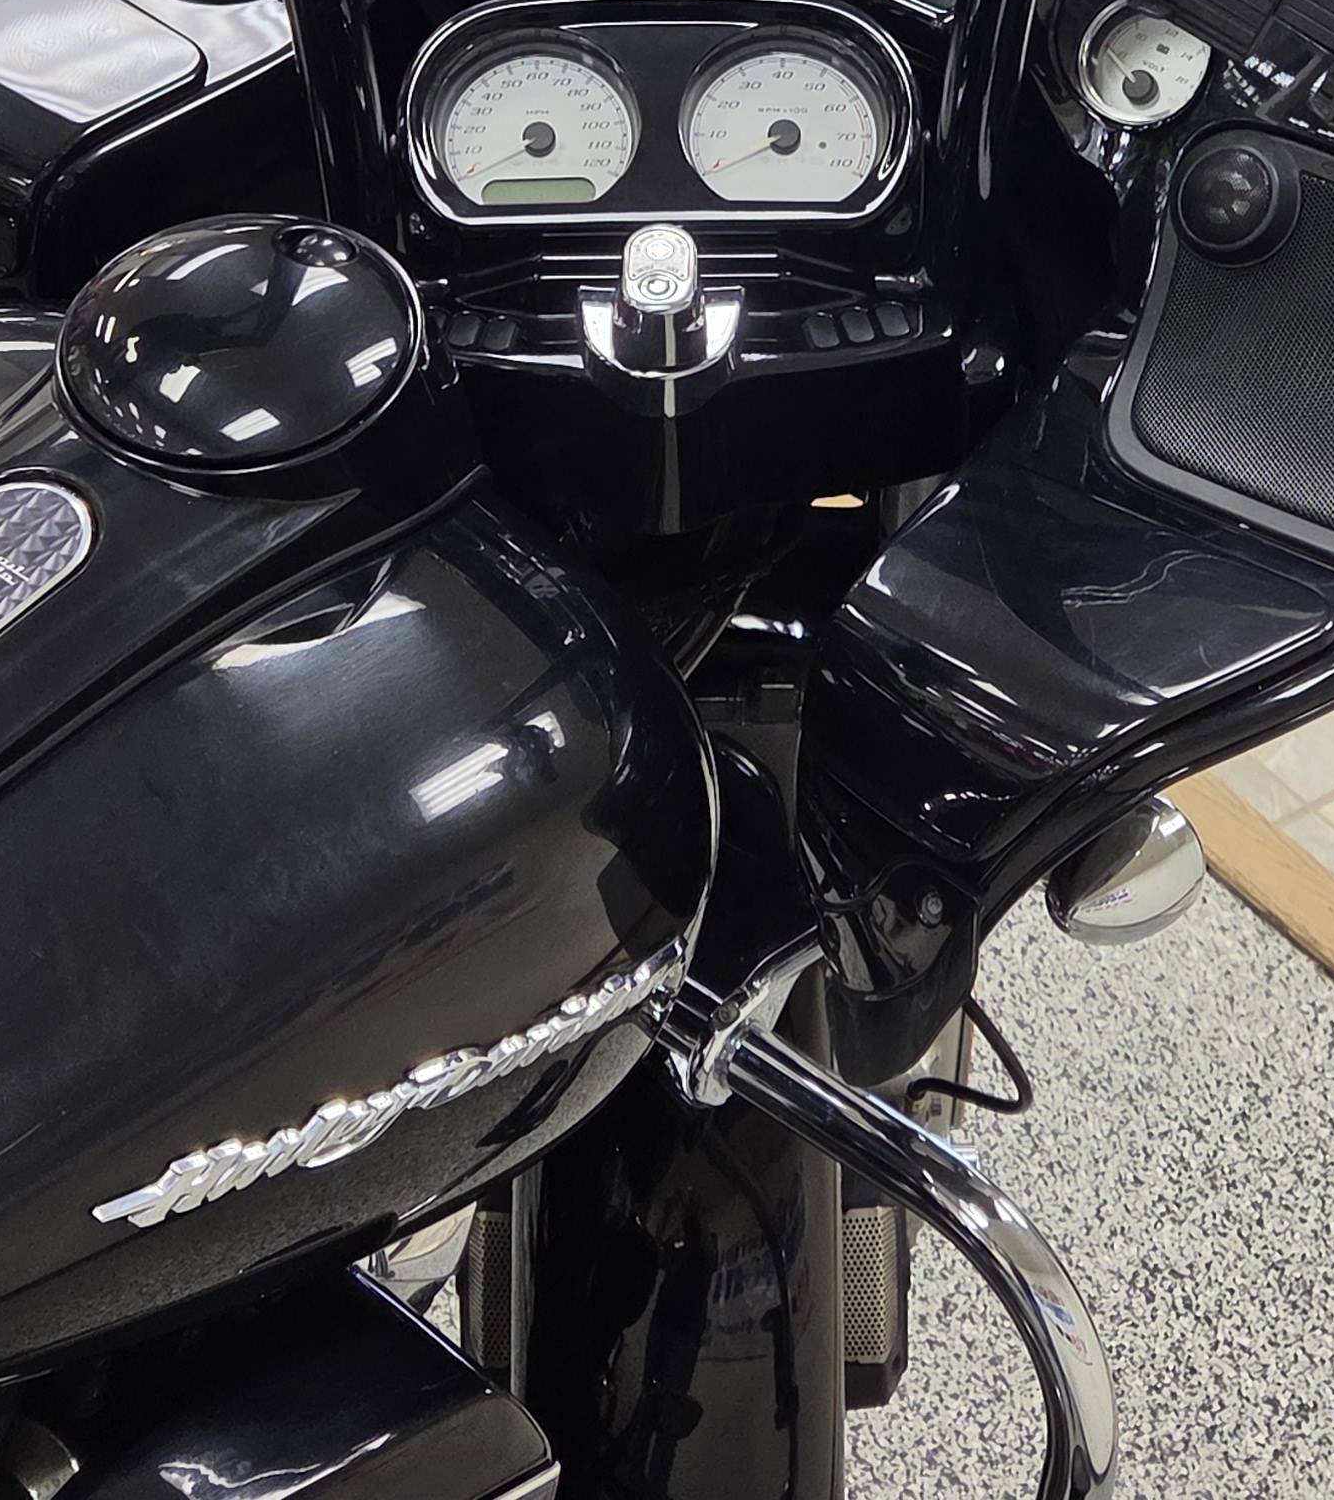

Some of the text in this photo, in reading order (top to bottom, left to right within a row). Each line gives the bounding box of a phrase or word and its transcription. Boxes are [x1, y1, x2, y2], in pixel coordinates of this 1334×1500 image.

[526, 72, 549, 81] 60
[772, 71, 794, 79] 40
[500, 79, 524, 89] 50
[552, 77, 572, 87] 70
[738, 82, 762, 90] 30
[803, 83, 826, 91] 50
[481, 92, 503, 101] 40
[567, 88, 590, 97] 80
[579, 102, 602, 112] 90
[717, 101, 740, 109] 20
[824, 104, 847, 112] 60
[470, 107, 493, 116] 30
[463, 125, 487, 134] 20
[581, 121, 610, 130] 100
[709, 131, 727, 139] 10
[837, 133, 857, 141] 70
[587, 140, 613, 149] 110
[465, 145, 483, 154] 10
[583, 158, 611, 167] 120
[829, 159, 853, 168] 80
